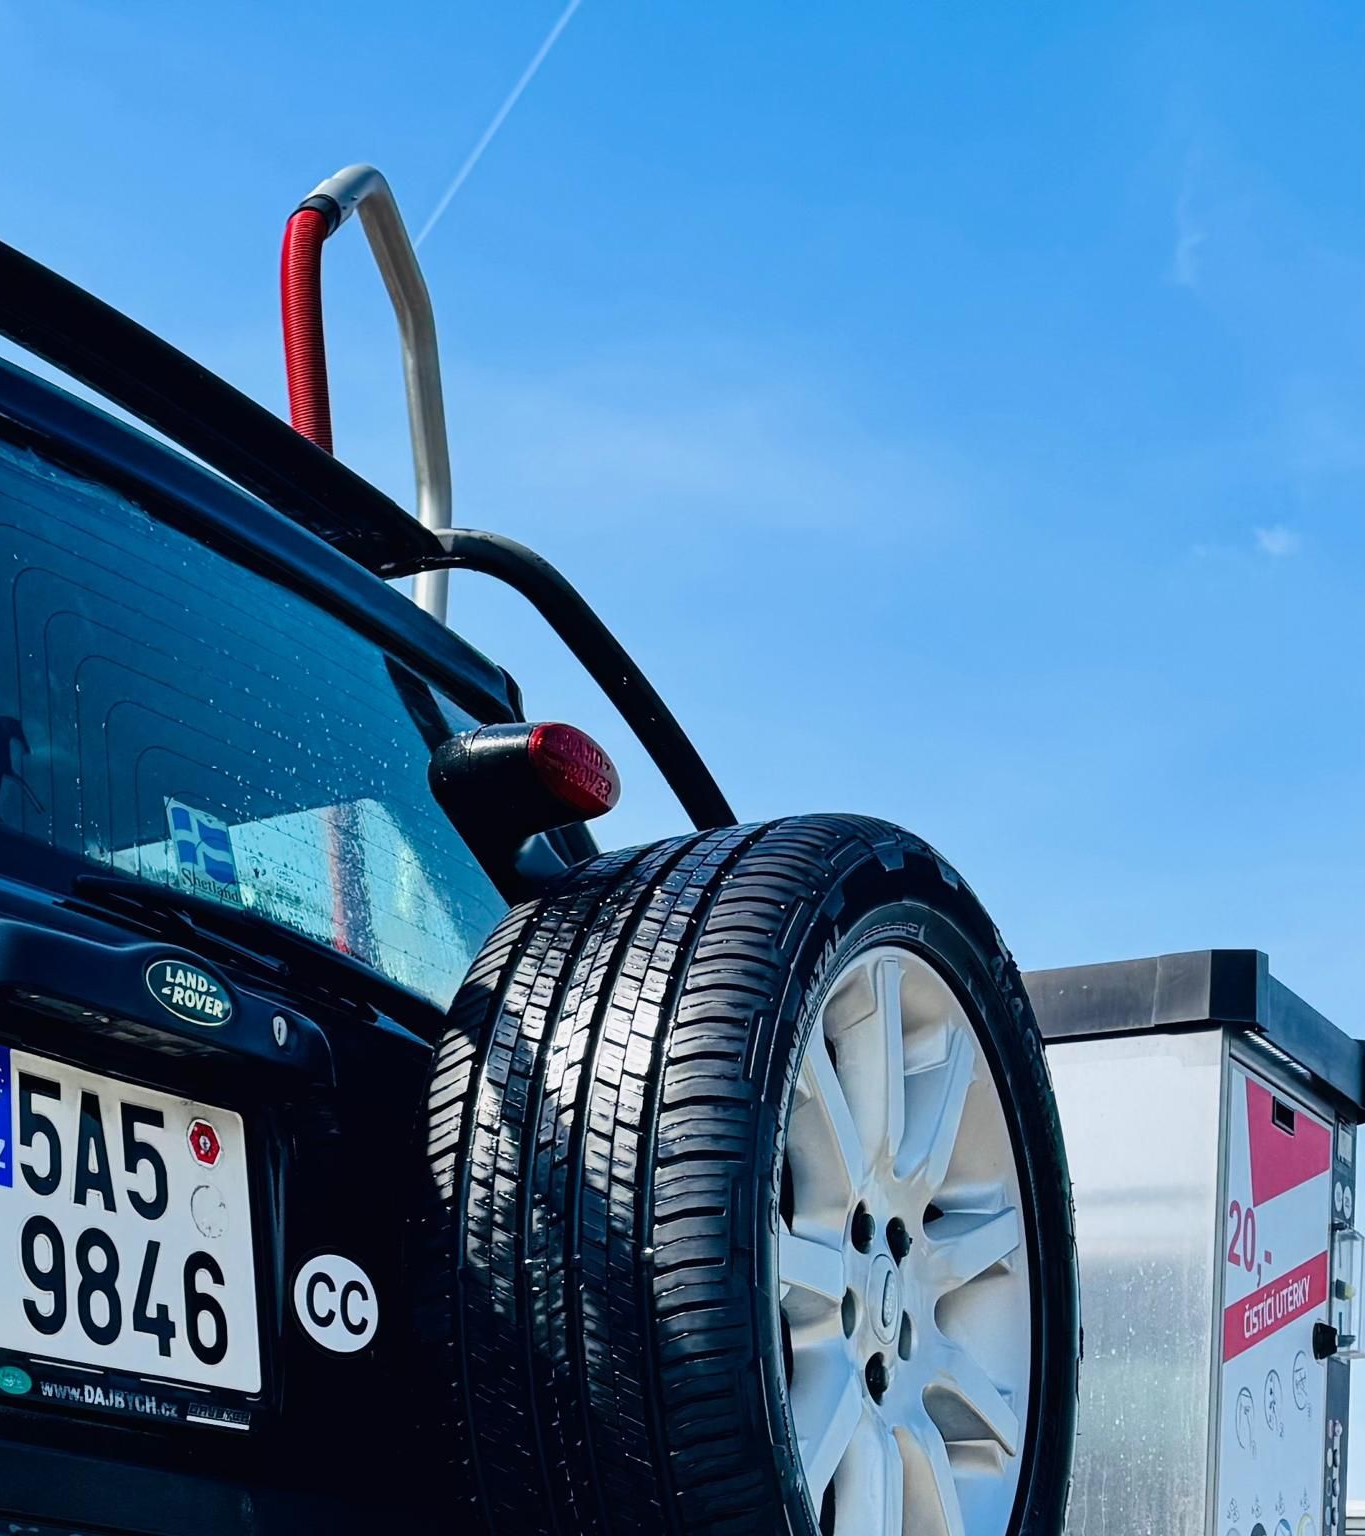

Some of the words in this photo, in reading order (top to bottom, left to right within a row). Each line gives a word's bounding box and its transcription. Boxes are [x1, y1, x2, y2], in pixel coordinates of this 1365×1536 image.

[180, 868, 240, 901] Shetland
[165, 965, 209, 992] LAND
[171, 985, 224, 1019] ROVER
[18, 1071, 169, 1221] 5A5
[20, 1215, 229, 1366] 9846
[305, 1271, 369, 1336] CC
[1243, 1288, 1275, 1339] ČISTÍCÍ
